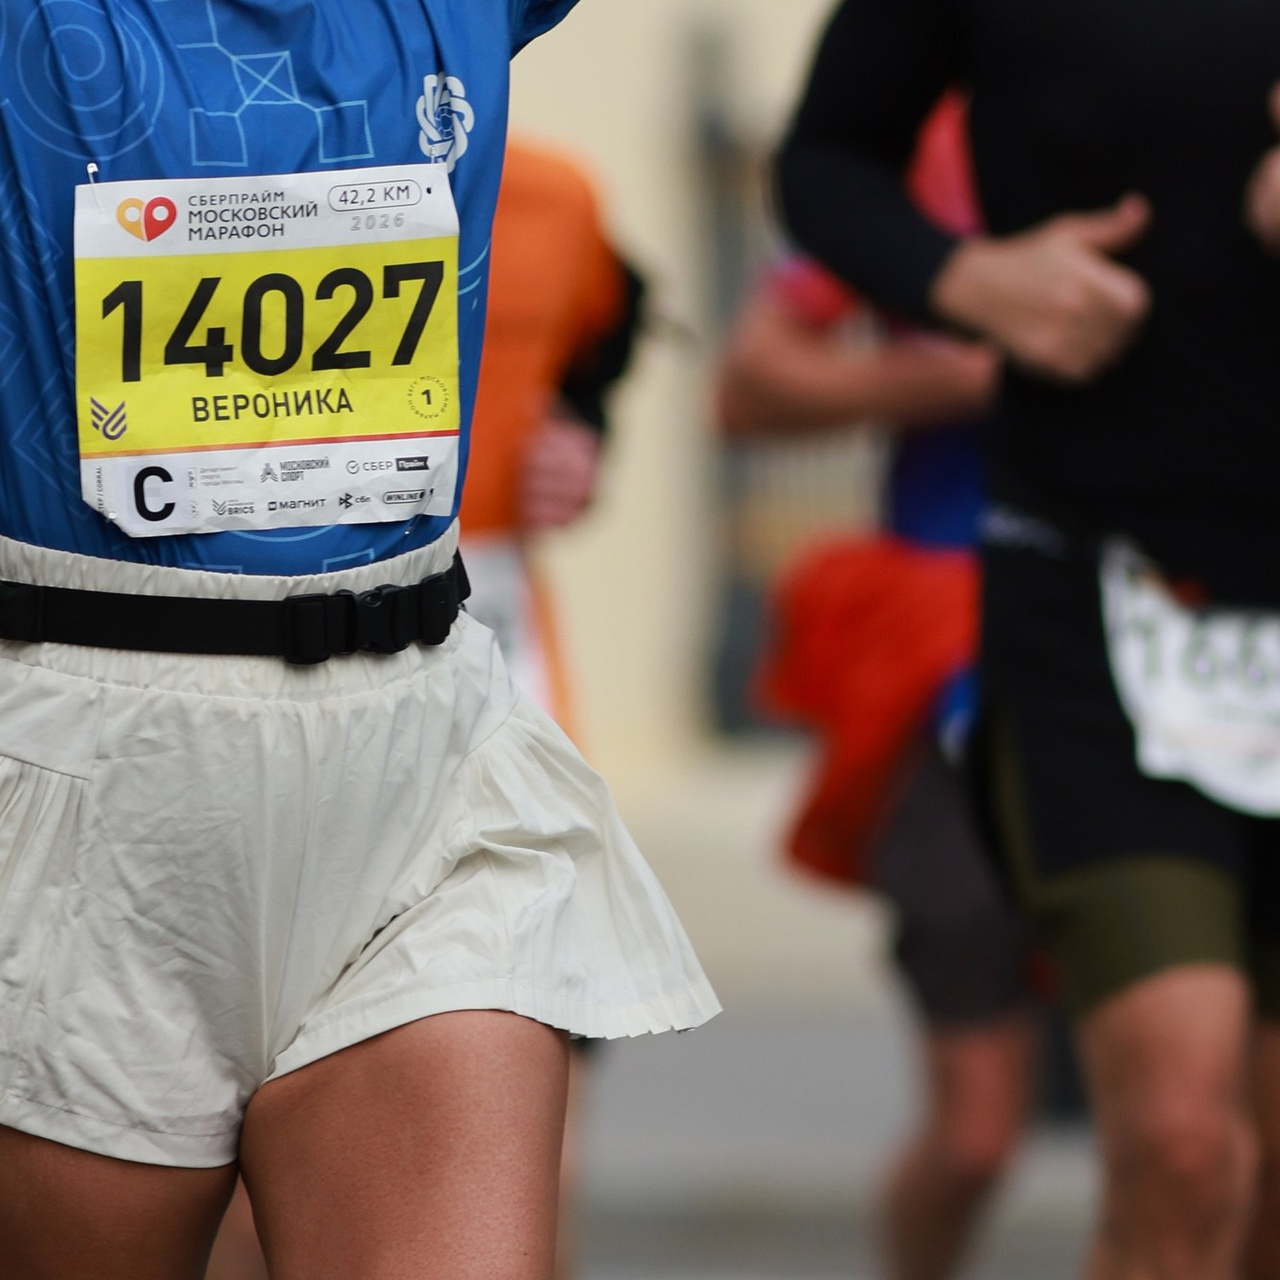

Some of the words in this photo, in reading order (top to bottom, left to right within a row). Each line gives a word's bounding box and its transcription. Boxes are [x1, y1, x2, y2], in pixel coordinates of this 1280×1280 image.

[188, 190, 285, 207] СБЕРПРАЙМ
[338, 188, 375, 206] 42,2
[383, 186, 411, 202] КМ
[188, 202, 319, 224] МОСКОВСКИЙ
[350, 213, 405, 232] 2026
[188, 223, 285, 242] МАРАФОН
[102, 260, 445, 383] 14027
[192, 387, 354, 423] ВЕРОНИКА
[421, 389, 432, 405] 1
[362, 461, 394, 471] СБЕР
[386, 491, 420, 502] WINLINE
